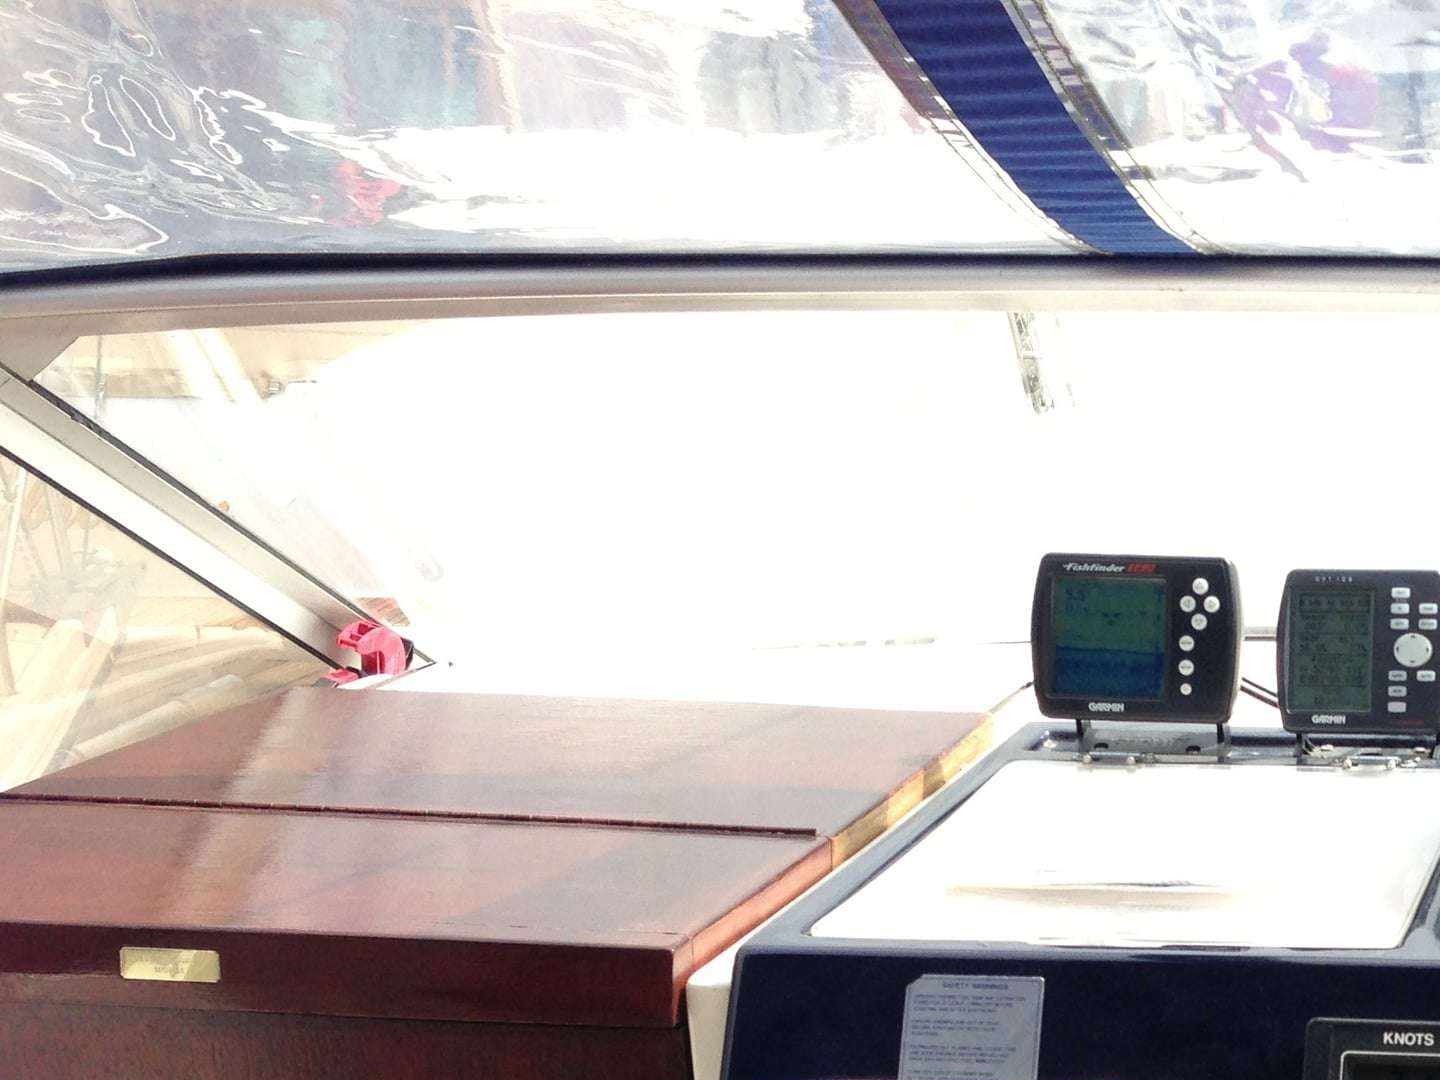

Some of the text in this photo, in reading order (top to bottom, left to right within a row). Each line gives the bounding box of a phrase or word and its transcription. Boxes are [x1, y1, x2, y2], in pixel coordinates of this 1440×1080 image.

[1062, 562, 1126, 573] Fishfinder
[1088, 702, 1125, 713] GARMIN
[1311, 714, 1346, 725] GARMIN
[1383, 1031, 1435, 1046] KNOTS
